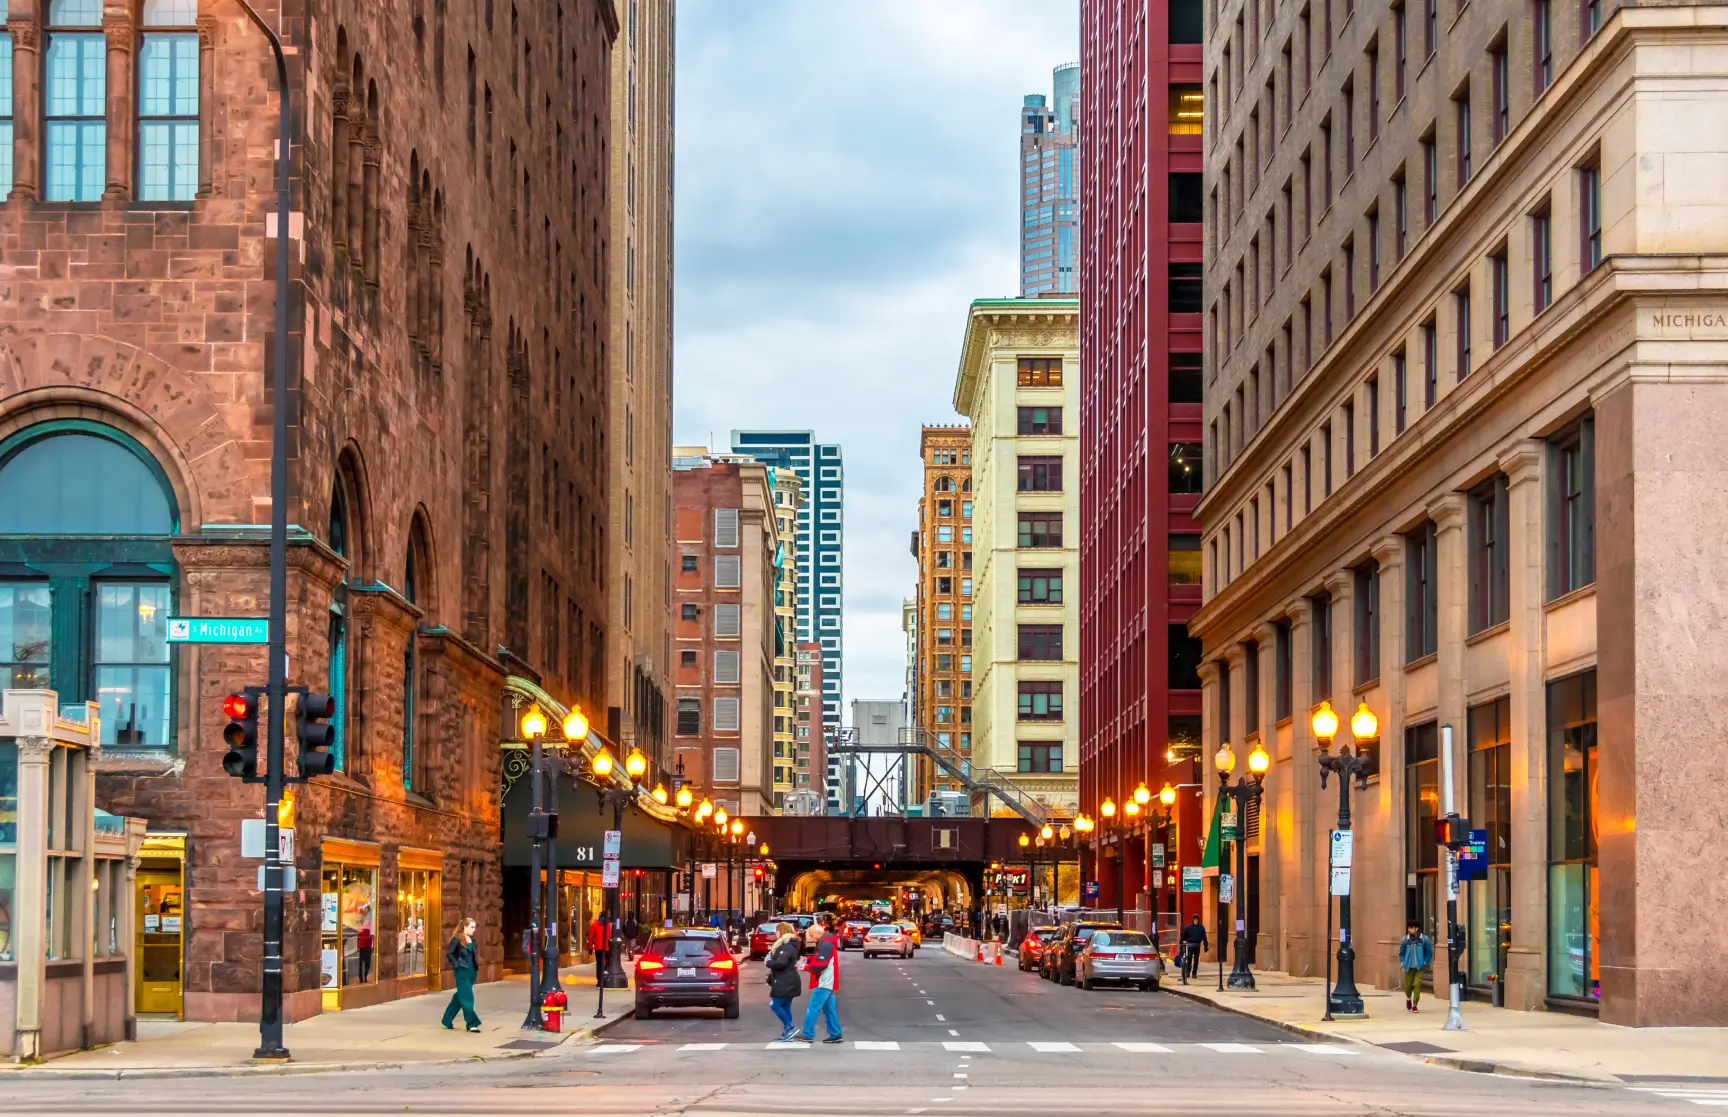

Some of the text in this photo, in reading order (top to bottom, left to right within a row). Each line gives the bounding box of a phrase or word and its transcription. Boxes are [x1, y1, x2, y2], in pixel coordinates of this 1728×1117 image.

[1652, 314, 1728, 327] MICHIGA
[192, 625, 197, 633] S
[200, 622, 253, 640] Michigan
[576, 846, 594, 861] 81
